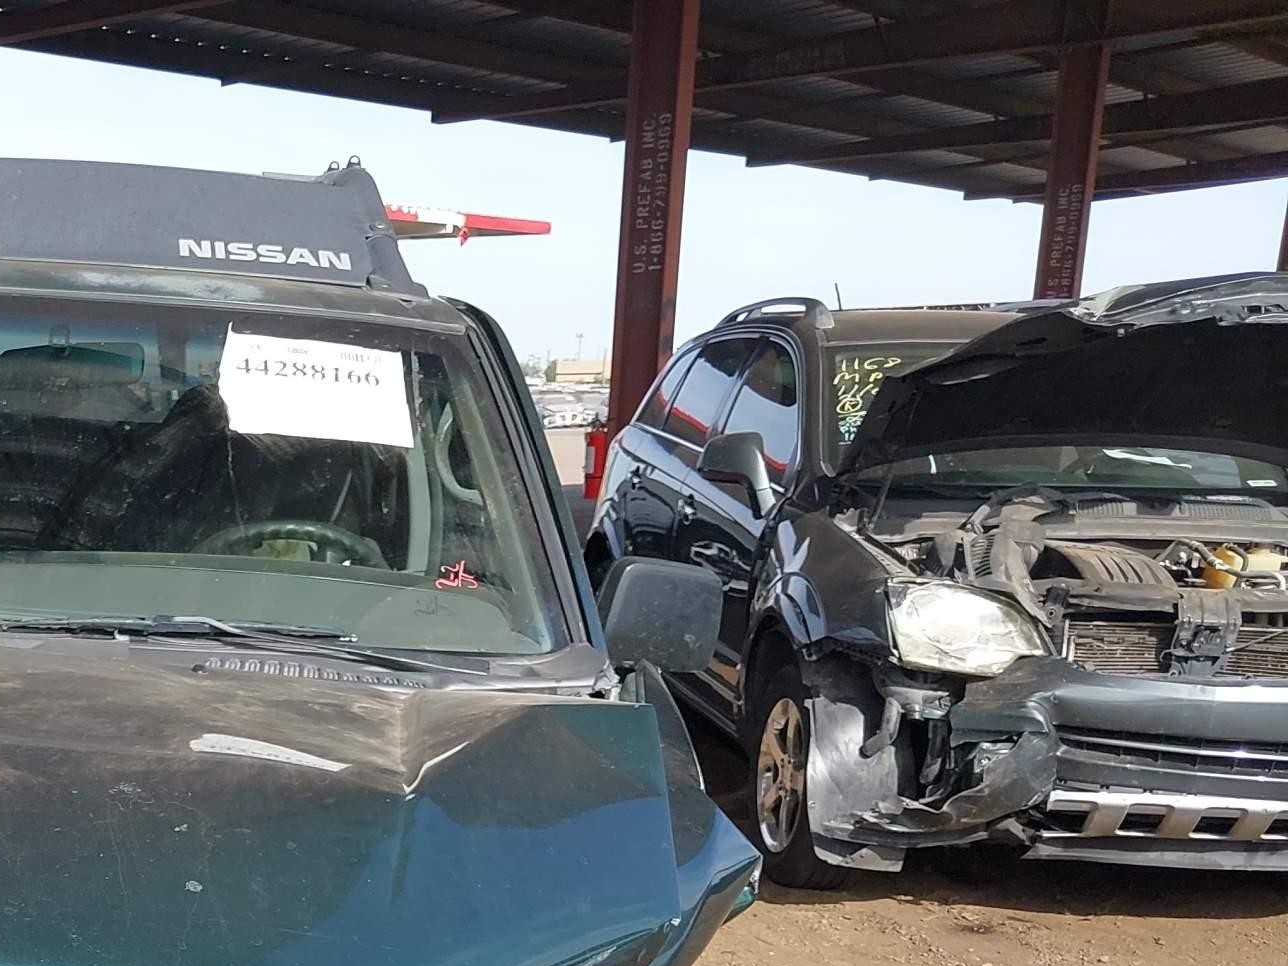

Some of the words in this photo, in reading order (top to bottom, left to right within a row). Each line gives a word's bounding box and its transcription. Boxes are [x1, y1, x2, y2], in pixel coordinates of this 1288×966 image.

[635, 158, 654, 229] PREFAB
[178, 238, 352, 271] NISSAN
[236, 357, 381, 386] 44288166
